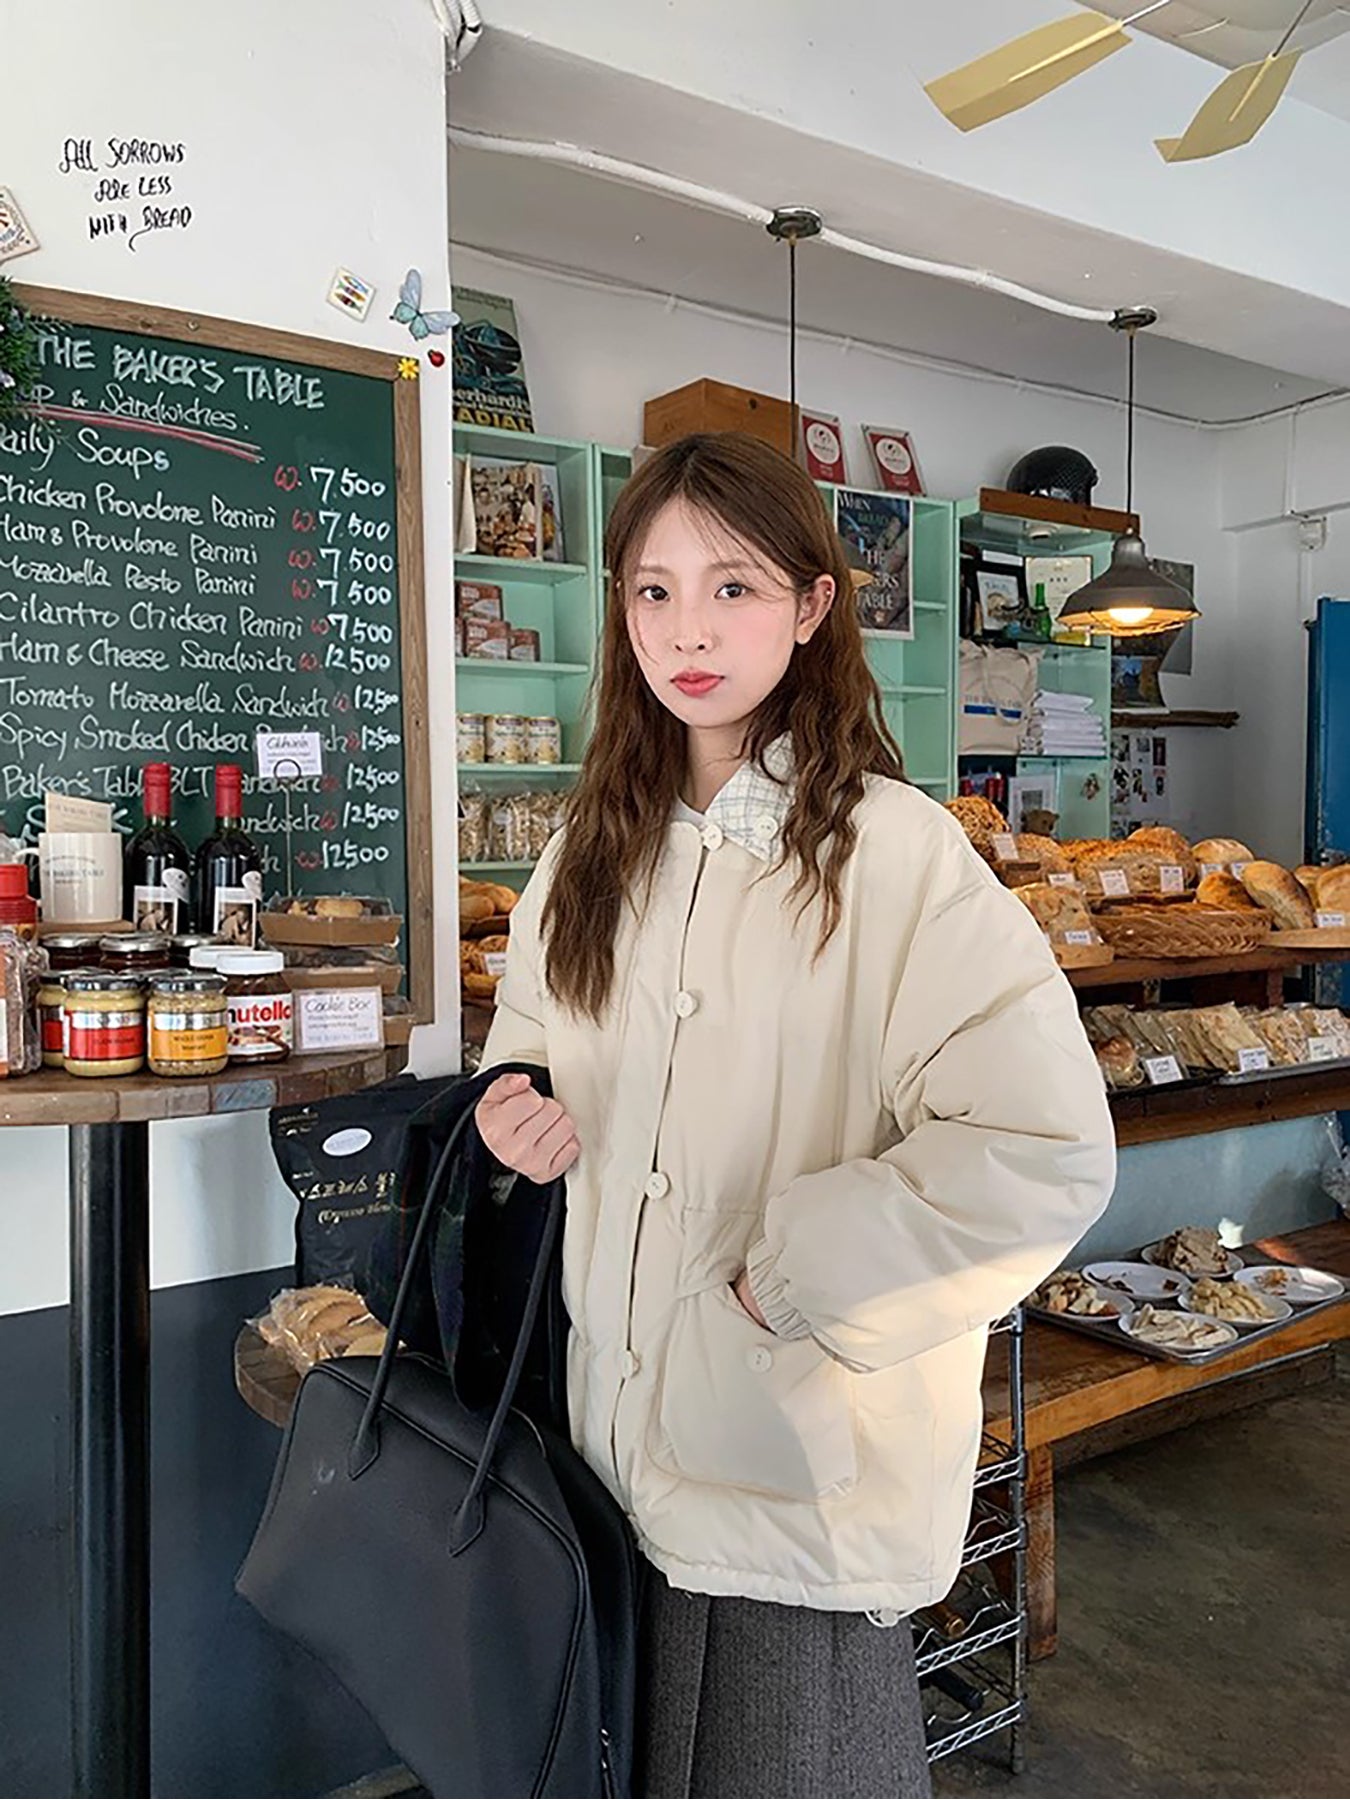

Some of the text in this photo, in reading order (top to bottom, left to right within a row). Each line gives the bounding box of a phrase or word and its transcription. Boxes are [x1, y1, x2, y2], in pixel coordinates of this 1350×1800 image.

[106, 137, 186, 168] SORROWS
[138, 176, 172, 196] LESS
[129, 206, 192, 251] BREAD
[38, 334, 96, 369] THE
[233, 367, 325, 408] TABLE
[72, 389, 88, 407] &
[457, 408, 531, 433] ADIAL
[0, 422, 170, 480] aily Soups
[211, 494, 276, 529] Panini
[189, 532, 258, 564] Panini
[125, 562, 181, 595] Pesto
[195, 566, 257, 597] Panini
[0, 591, 120, 629] Cilantro
[129, 601, 227, 635] Chicken
[239, 605, 303, 640] Panini
[0, 632, 60, 664] Ham
[88, 638, 170, 672] Cheese
[180, 640, 296, 674] Sandwich
[0, 675, 94, 710] Tomato
[231, 682, 330, 718] Sandwich
[0, 711, 67, 761] Spicy
[74, 714, 170, 752] Smoked
[2, 763, 92, 799] Baker's
[93, 765, 146, 797] Tabl
[240, 803, 321, 834] ndwich
[227, 1001, 291, 1023] nutella
